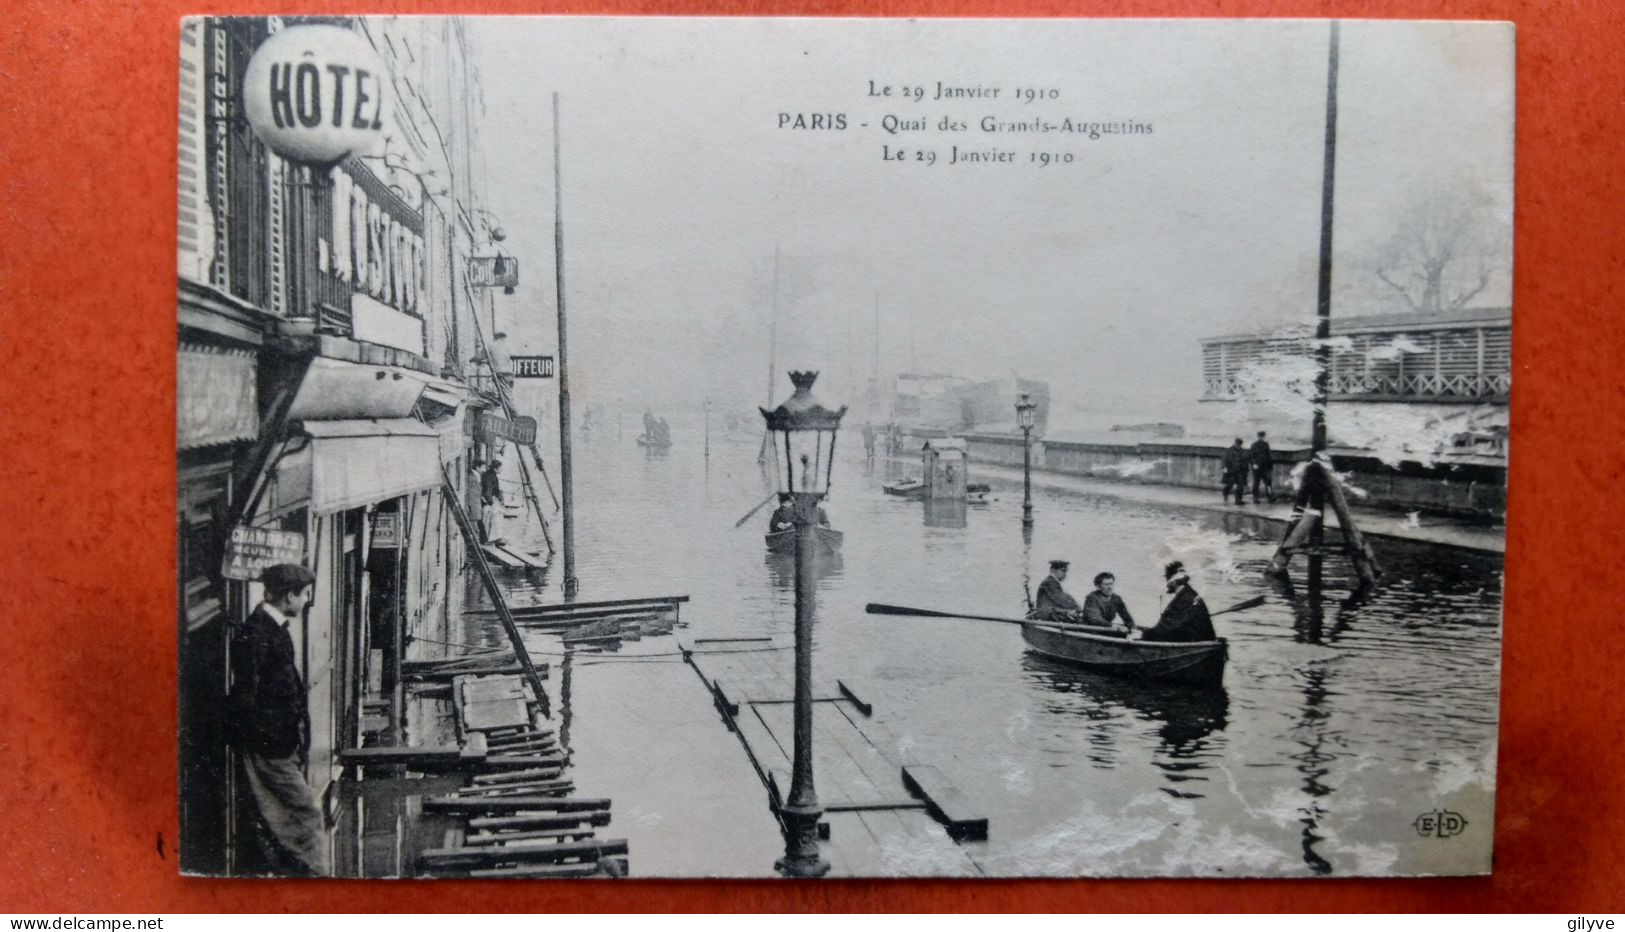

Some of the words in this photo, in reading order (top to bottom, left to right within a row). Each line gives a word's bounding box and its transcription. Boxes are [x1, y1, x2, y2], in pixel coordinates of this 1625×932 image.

[270, 50, 382, 130] HÔTEL
[868, 80, 892, 97] Le
[902, 86, 924, 103] 29
[933, 81, 1001, 100] Janvier
[1015, 87, 1060, 105] 1910
[777, 112, 848, 130] PARIS
[882, 114, 926, 135] Quai
[937, 116, 968, 131] des
[980, 115, 1153, 140] Grands-Augustins
[882, 145, 905, 162] Le
[916, 150, 937, 166] 29
[949, 145, 1016, 165] Janvier
[1030, 151, 1074, 168] 1910
[512, 359, 553, 375] IFFEUR
